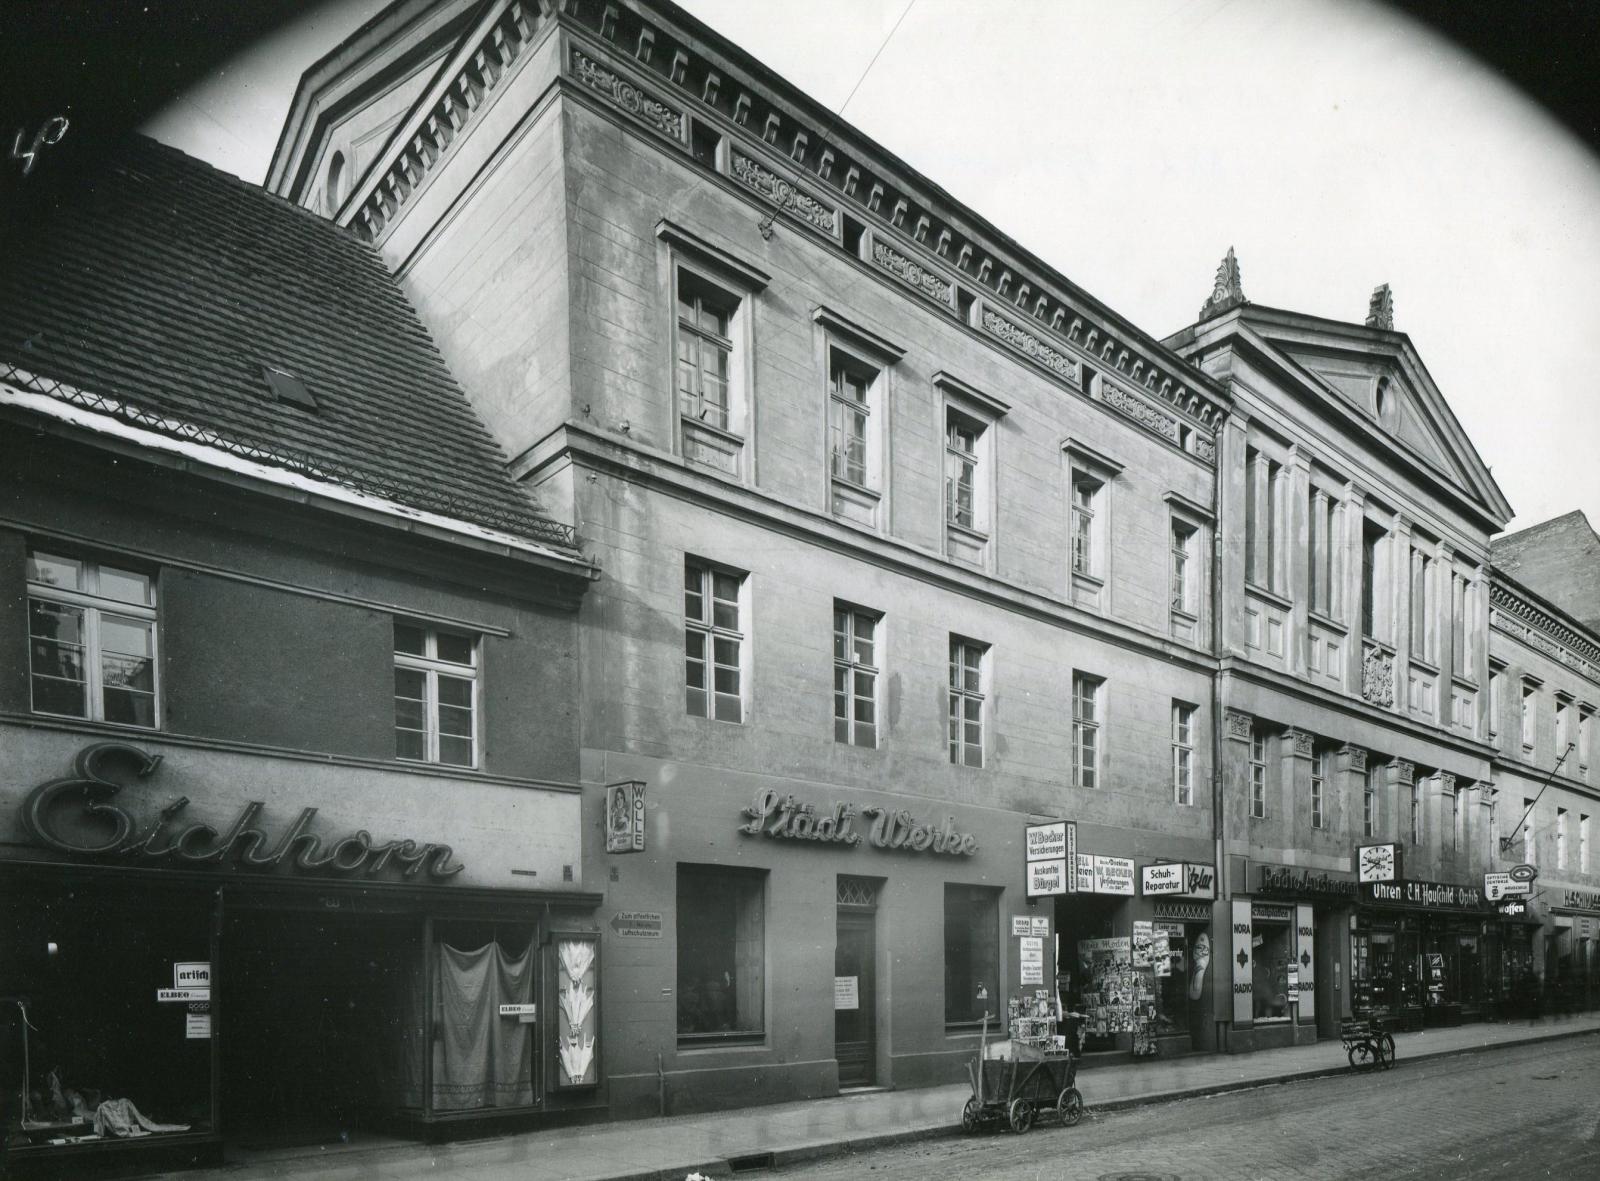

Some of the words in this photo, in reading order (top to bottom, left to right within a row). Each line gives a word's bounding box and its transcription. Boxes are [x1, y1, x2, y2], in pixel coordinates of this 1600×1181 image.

[21, 743, 465, 879] Eichhorn
[633, 787, 644, 846] WOLLE
[861, 804, 980, 857] Werke
[1151, 869, 1175, 879] Schuh-
[1033, 876, 1060, 891] Bürgel
[1145, 881, 1180, 891] Reparatur
[1373, 883, 1401, 899] Uhren
[1233, 923, 1251, 934] NORA
[1299, 926, 1313, 937] NORA
[1234, 983, 1252, 993] RADIO
[1298, 982, 1314, 991] RADIO
